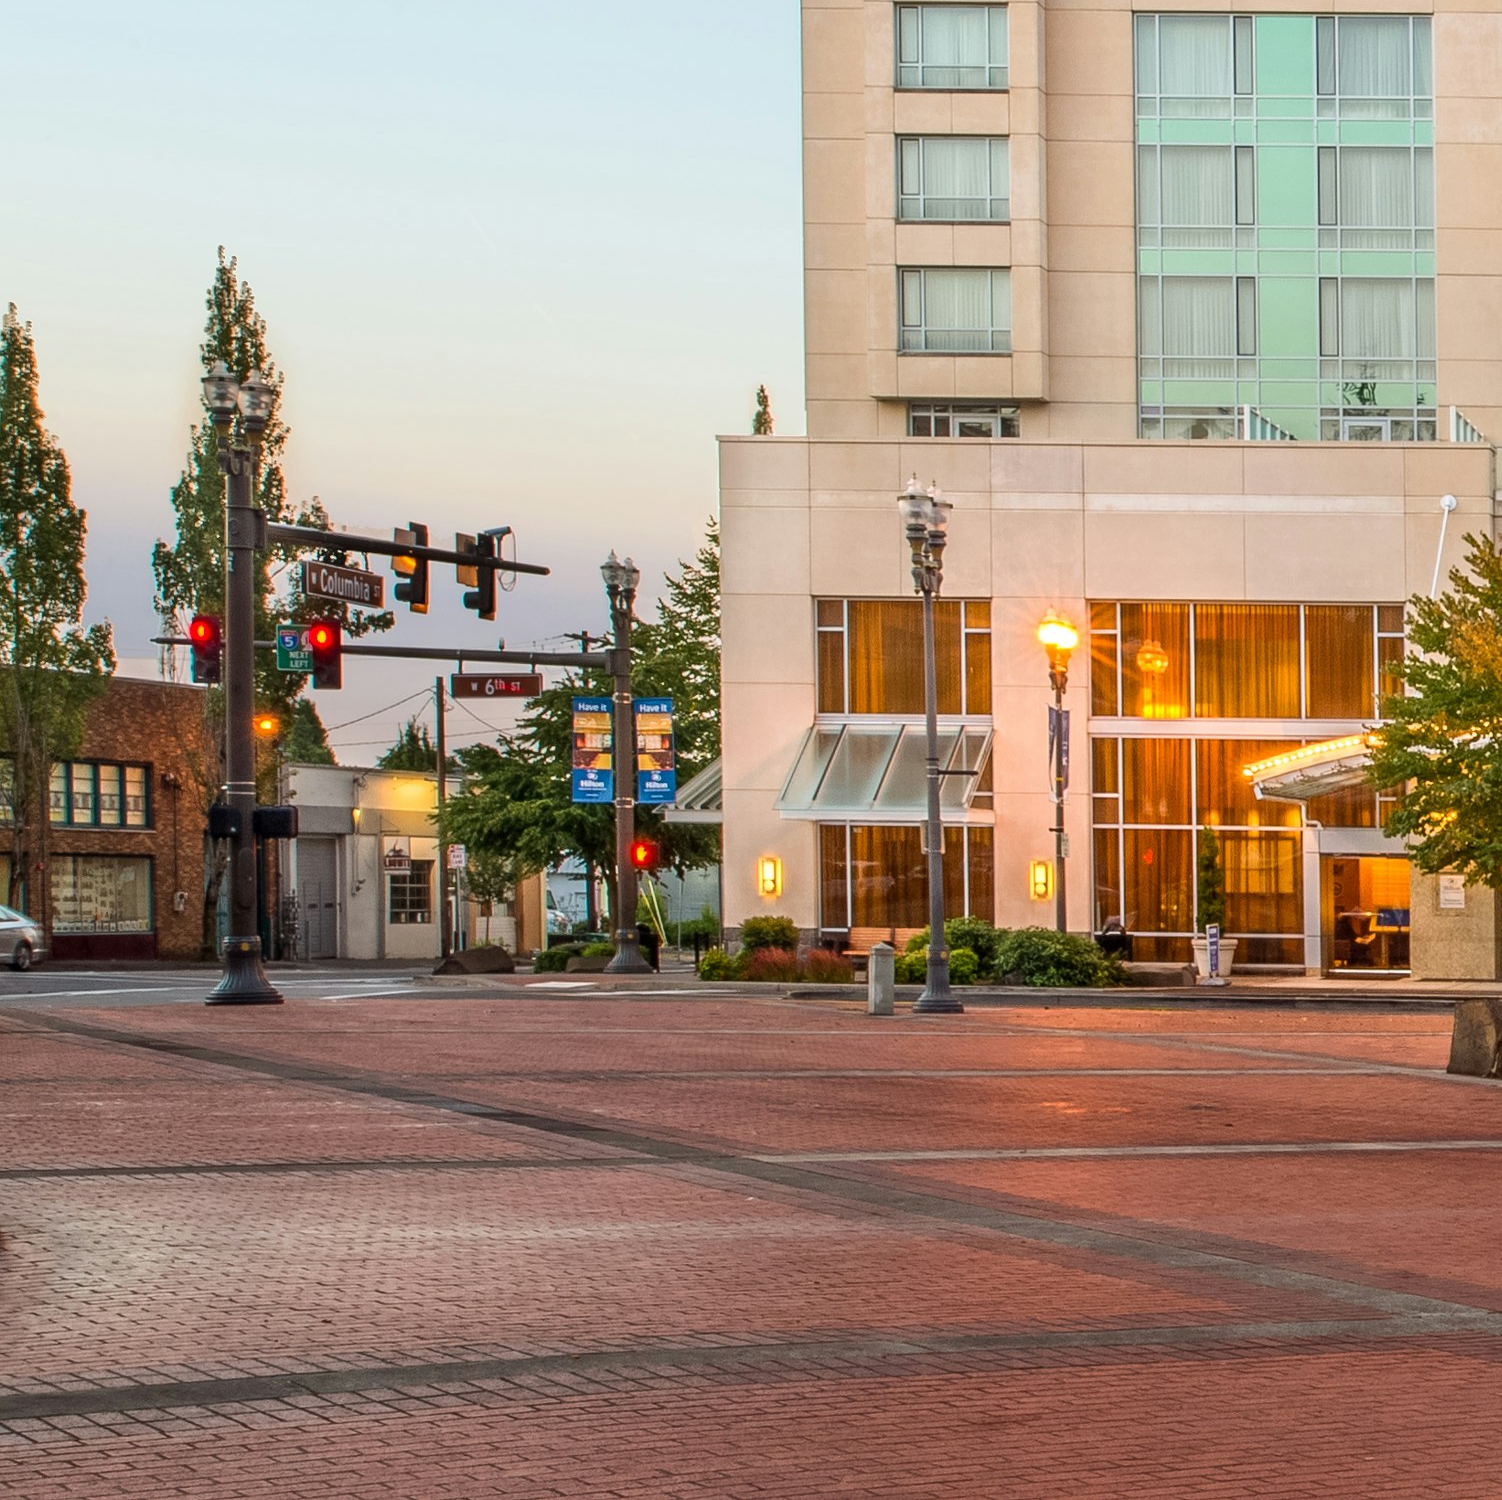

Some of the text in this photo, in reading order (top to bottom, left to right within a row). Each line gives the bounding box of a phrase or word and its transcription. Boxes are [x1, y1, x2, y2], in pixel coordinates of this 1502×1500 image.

[320, 568, 370, 601] Columbia
[285, 636, 294, 648] 5
[290, 660, 308, 668] LEFT
[485, 679, 505, 695] 6th
[511, 682, 521, 691] ST
[578, 703, 607, 711] Have it
[640, 704, 667, 712] Have it
[580, 780, 605, 788] Hilton
[645, 781, 668, 789] Hilton
